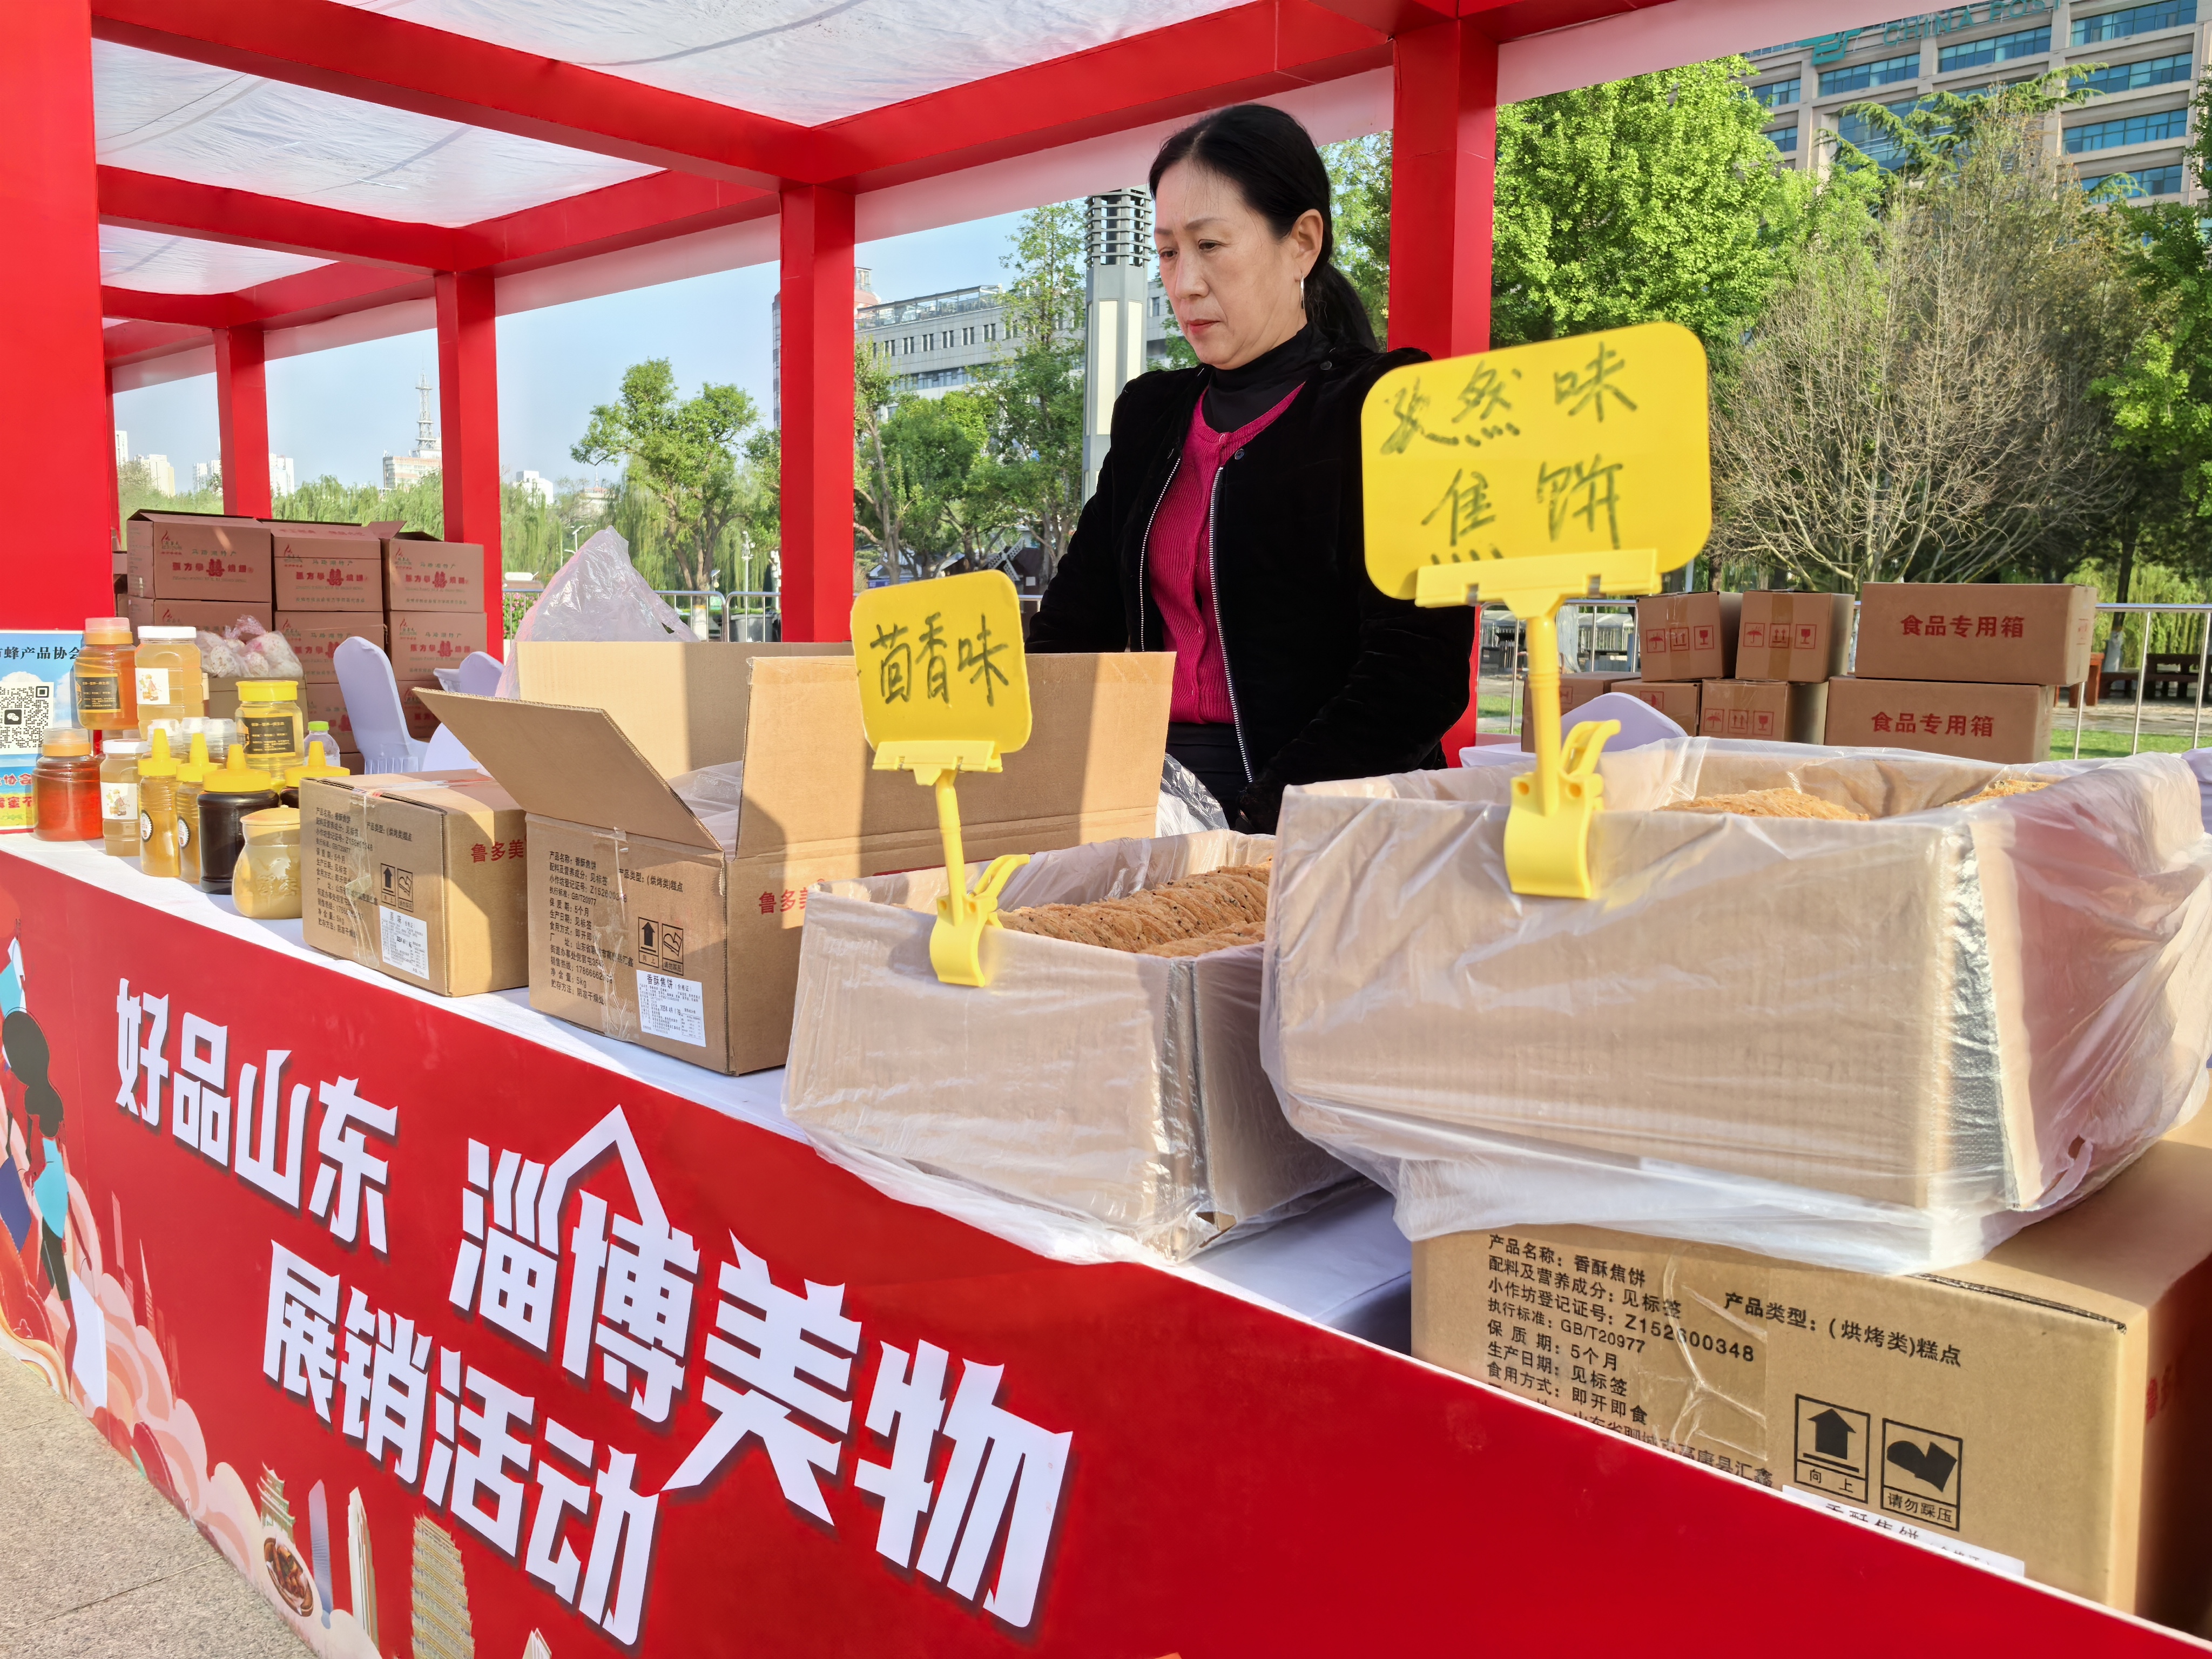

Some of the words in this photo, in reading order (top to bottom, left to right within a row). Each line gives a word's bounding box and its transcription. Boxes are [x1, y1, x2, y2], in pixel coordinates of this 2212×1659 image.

[1883, 5, 1975, 46] CHINA
[1421, 454, 1623, 565] 焦饼
[1900, 613, 2025, 638] 食品专用箱
[869, 611, 1009, 707] 茴香味
[1871, 711, 1994, 738] 食品专用箱
[470, 839, 525, 864] 鲁多美
[549, 851, 596, 871] 产品名称：香酥焦饼
[549, 862, 609, 886] 配料及营养成分：见标签
[549, 874, 628, 903] 小作坊登记证号：Z15260038
[549, 886, 597, 906] 执行标准：GB/T20977
[549, 898, 589, 917] 保质期：5个月
[550, 909, 592, 930] 生产日期：见标签
[550, 921, 595, 943] 食用方式：即开即
[642, 954, 656, 965] 向上
[664, 961, 682, 972] 请勿踩压
[550, 967, 587, 988] 净含量：5kg
[647, 974, 673, 989] 香酥焦饼
[115, 977, 398, 1254] 好品山东
[1488, 1233, 1646, 1289] 产品名称：香酥焦饼
[1488, 1254, 1682, 1319] 配料及营养成分：见标签
[1488, 1277, 1754, 1362] 小作坊登记证号：Z152600348
[1488, 1297, 1646, 1353] 执行标准：GB/T20977
[1724, 1292, 1961, 1367] 产品类型：(烘烤类)糕点
[1487, 1318, 1618, 1372] 保质期：5个月
[448, 1103, 1074, 1628] 淄博美物
[1487, 1341, 1628, 1397] 生产日期：见标签
[1487, 1360, 1649, 1426] 食用方式：即开即食
[262, 1239, 660, 1645] 展销活动
[1809, 1468, 1853, 1494] 向上
[1887, 1492, 1953, 1524] 请勿踩压
